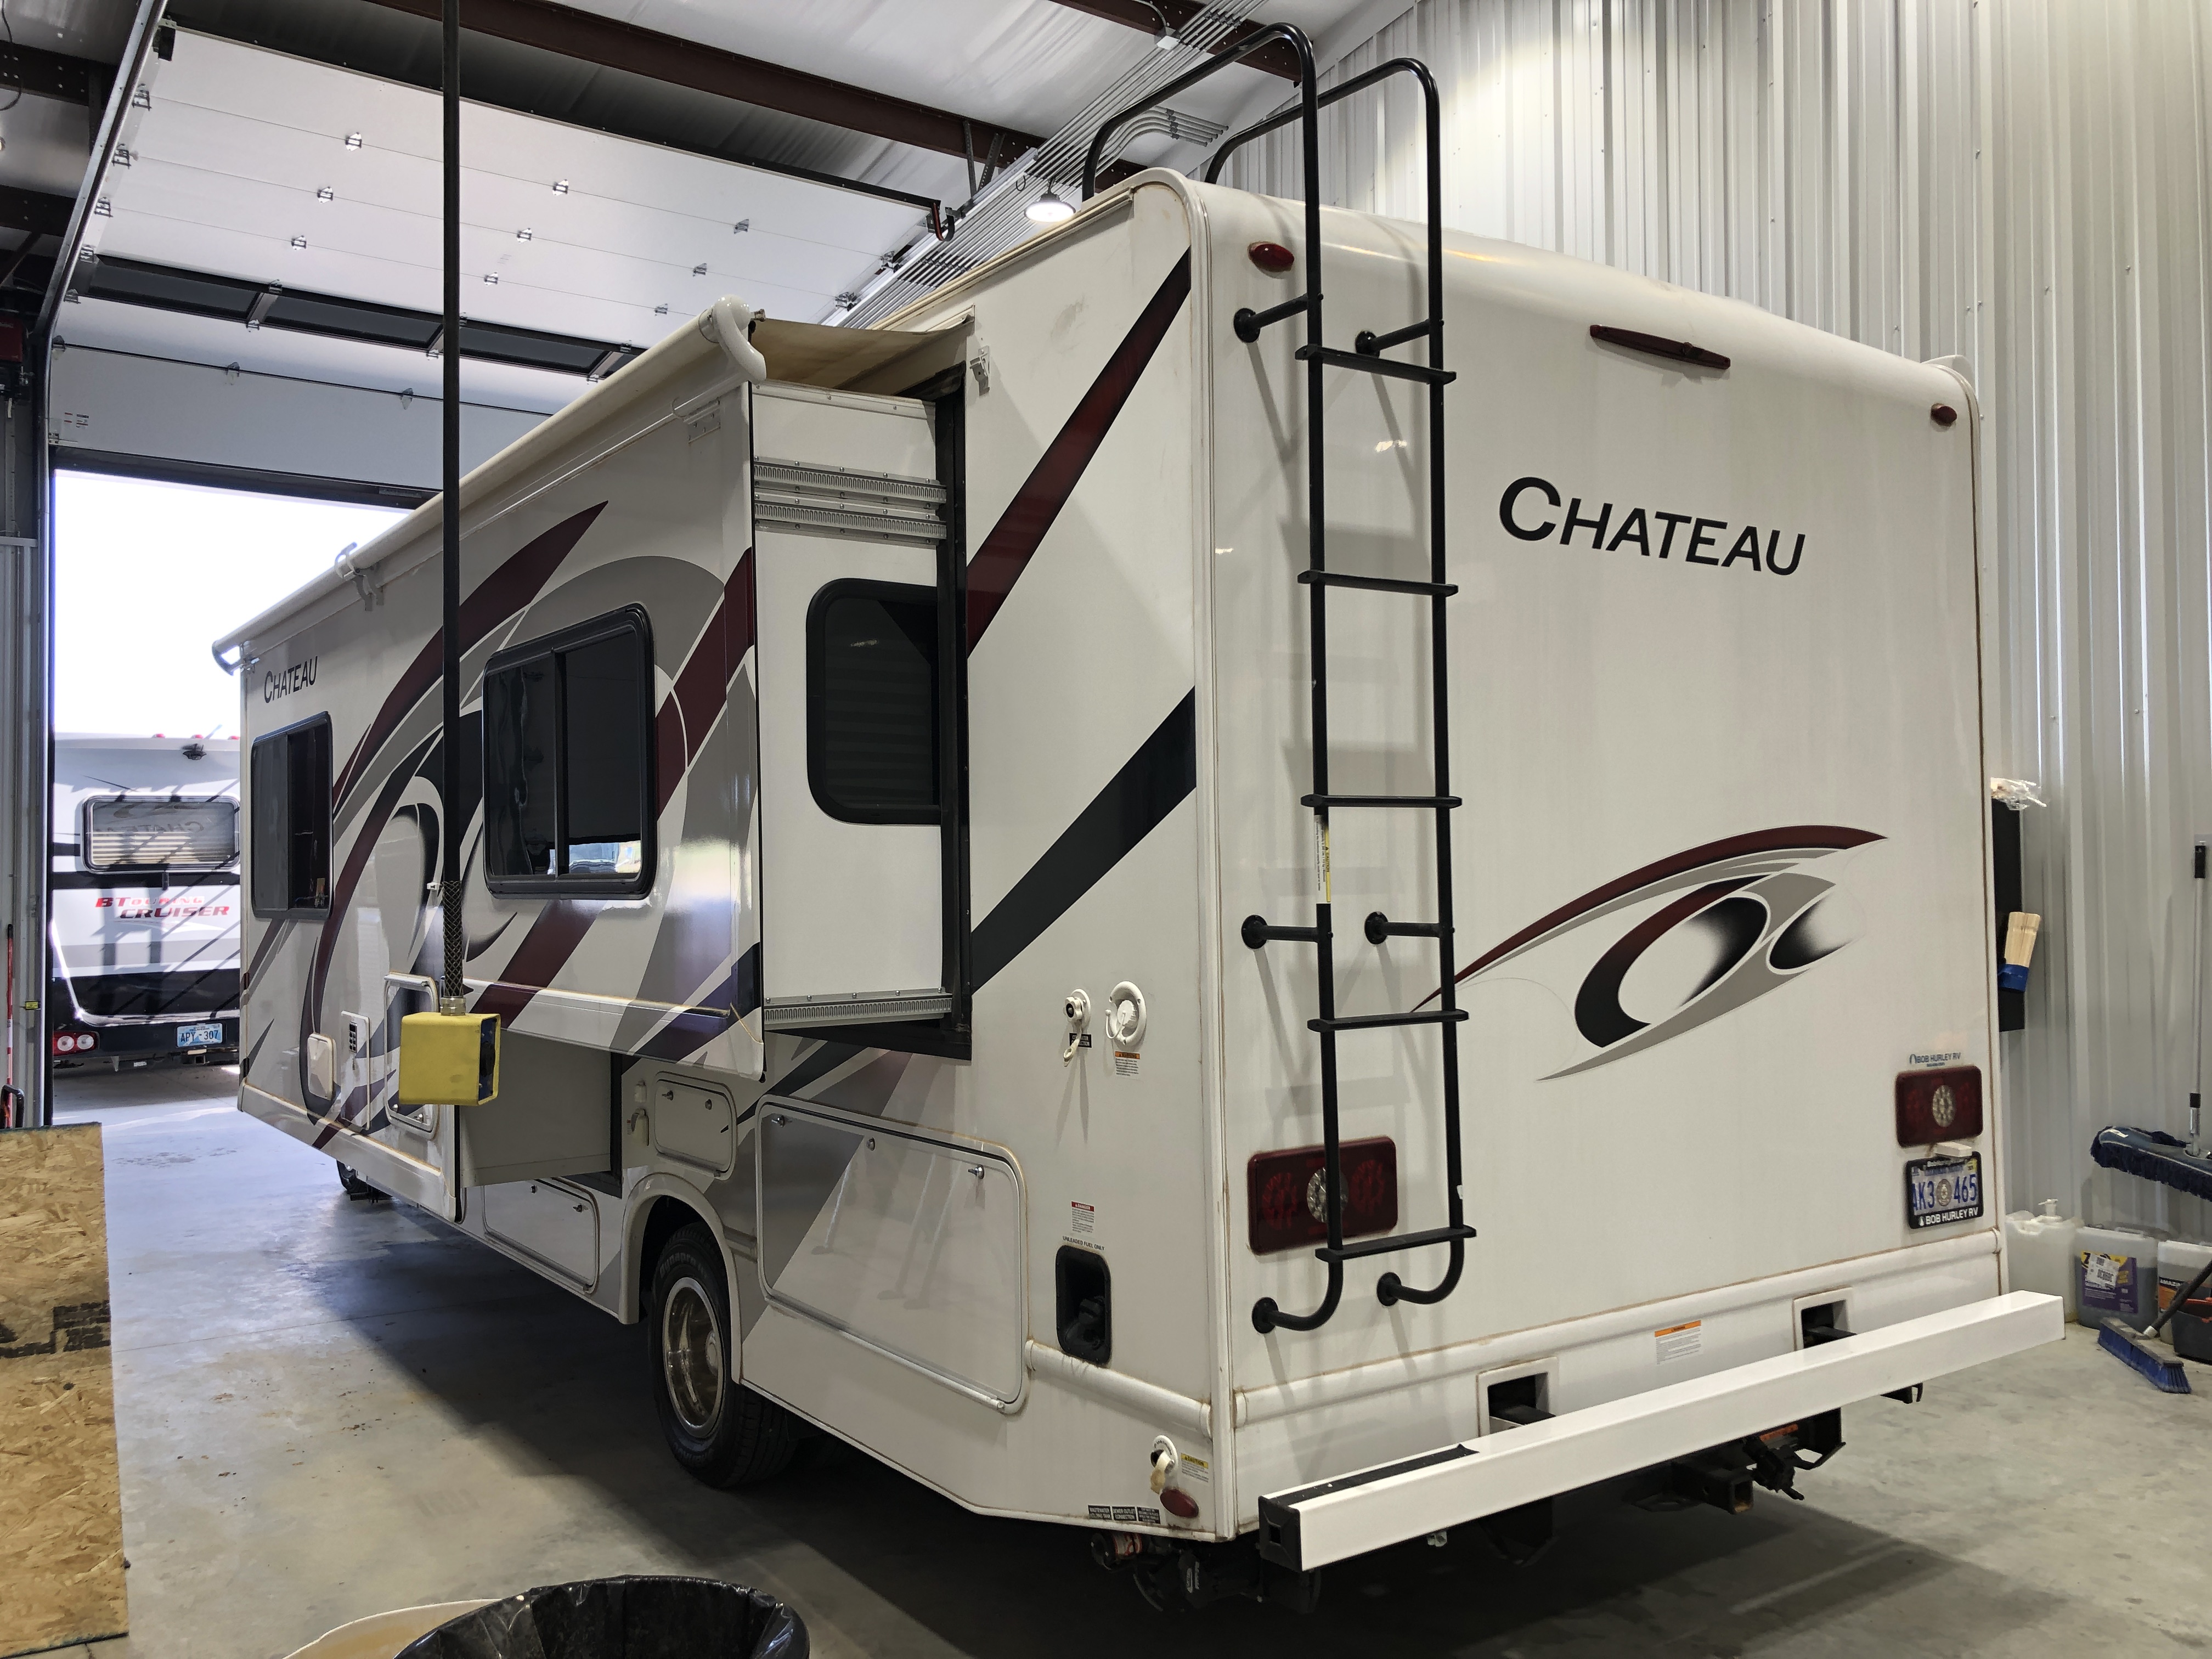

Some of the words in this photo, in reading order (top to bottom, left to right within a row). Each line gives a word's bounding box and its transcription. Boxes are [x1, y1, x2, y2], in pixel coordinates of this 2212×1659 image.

[1499, 476, 1806, 576] CHATEAU
[264, 656, 318, 703] CHATEAU
[120, 906, 230, 919] CRUISER
[1931, 1053, 1952, 1062] HURLEY
[1954, 1173, 1977, 1204] 465
[1925, 1214, 1942, 1225] BOB
[1942, 1208, 1968, 1222] HURLEY
[1968, 1207, 1979, 1217] RV
[1062, 1235, 1084, 1245] UNLEADED
